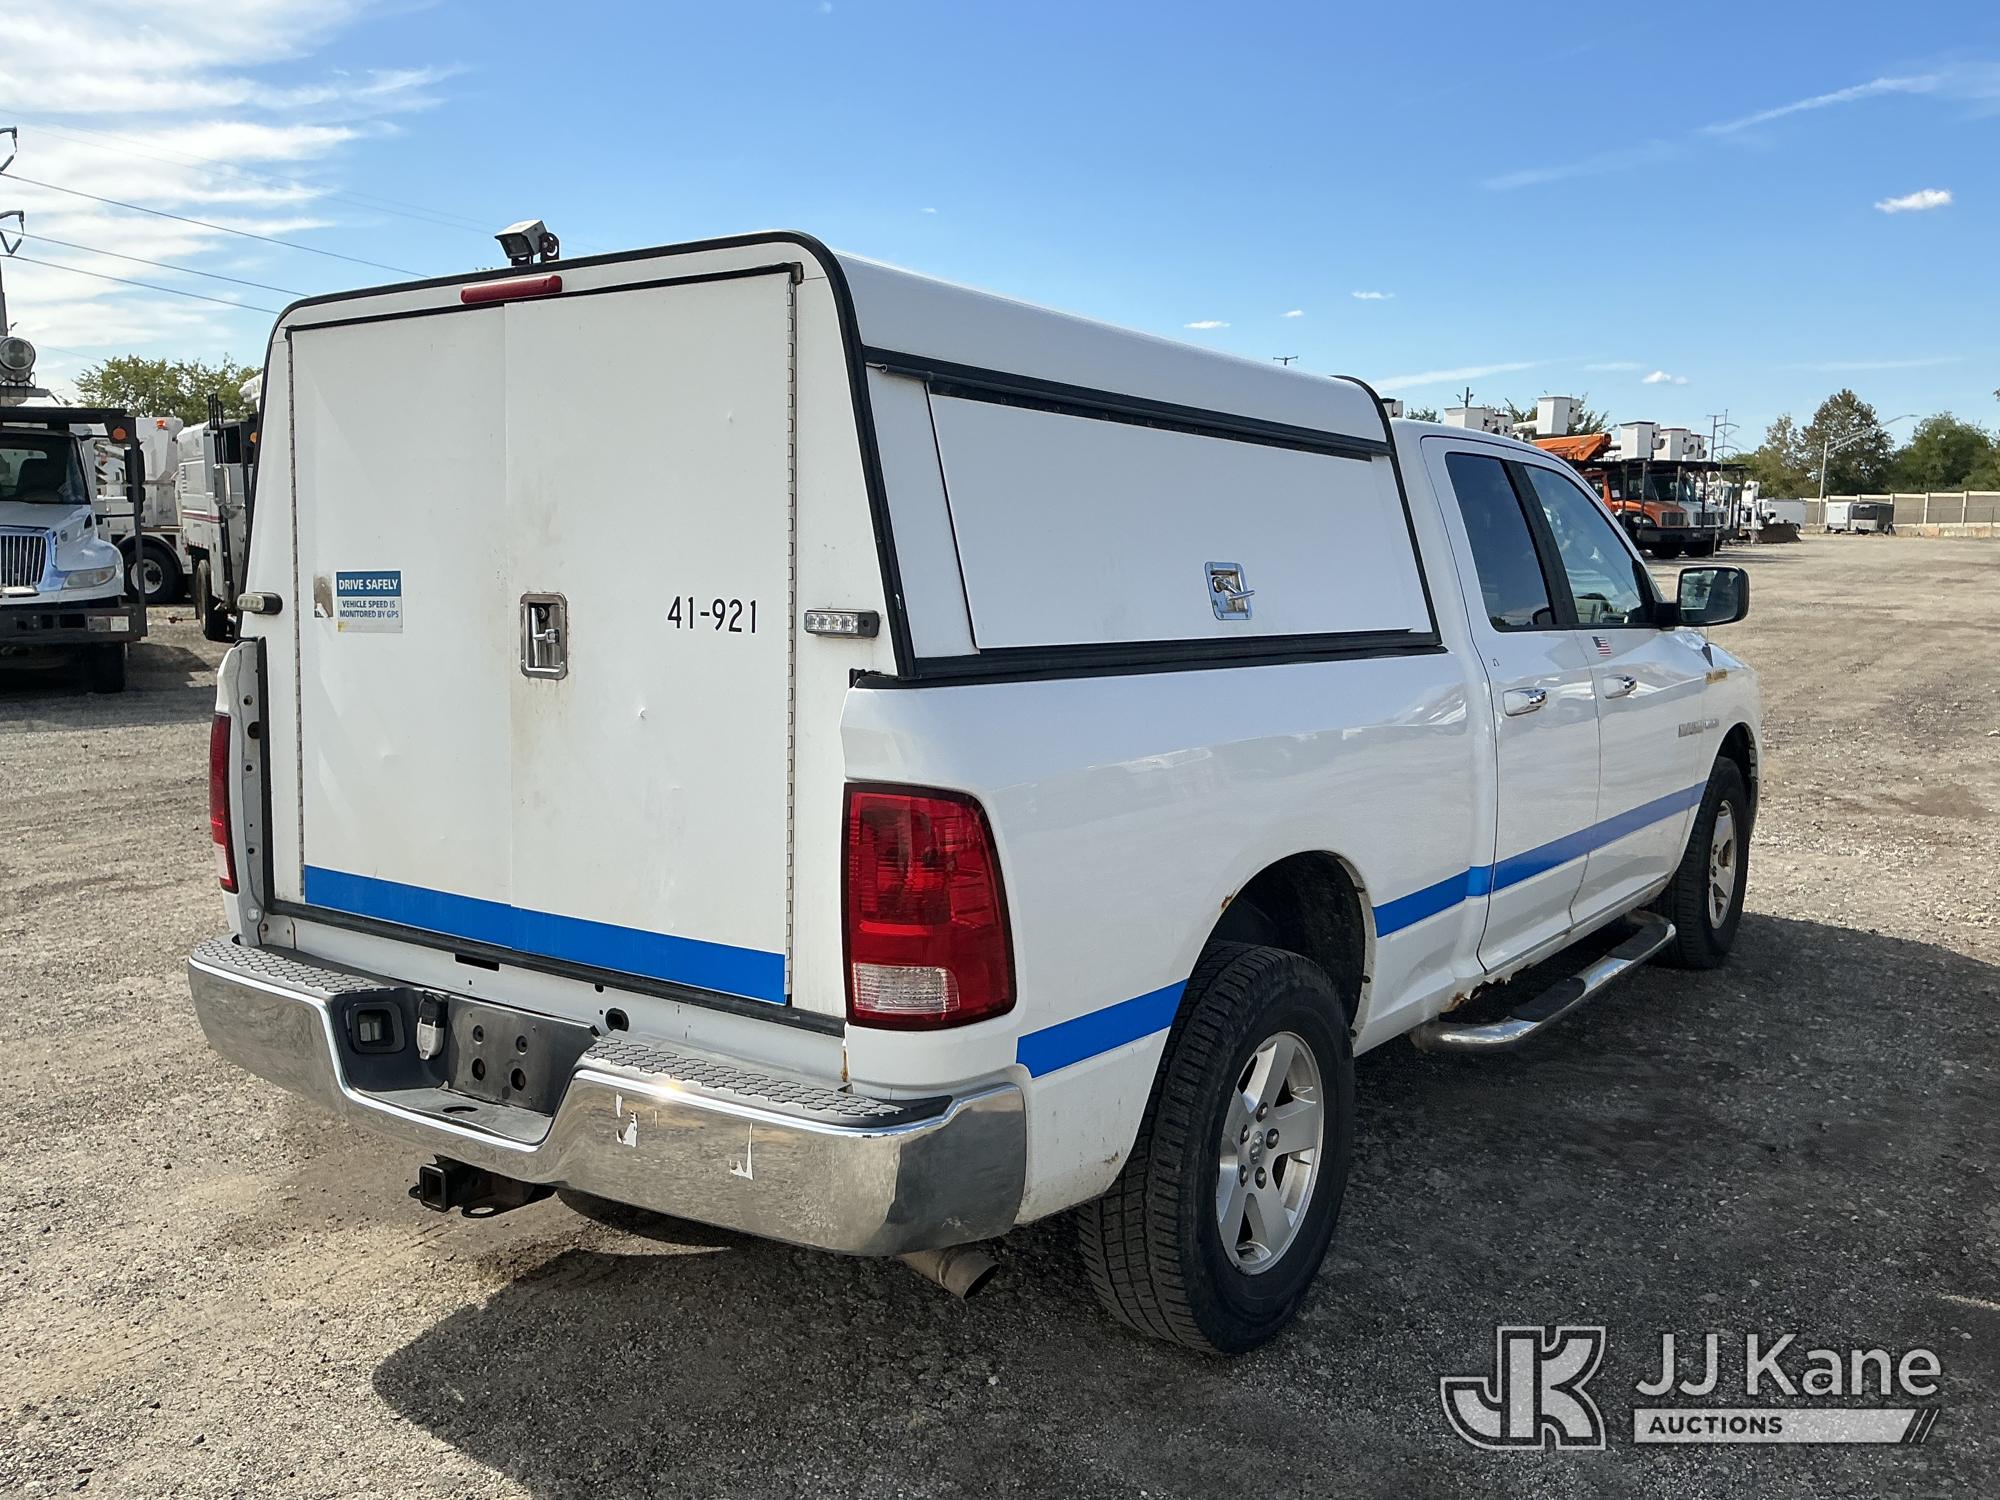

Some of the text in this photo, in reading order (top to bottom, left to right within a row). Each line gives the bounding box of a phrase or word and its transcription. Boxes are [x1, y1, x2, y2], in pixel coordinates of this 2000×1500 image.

[338, 578, 399, 591] DRIVE SAFELY
[342, 600, 396, 608] VEHICLE SPEED IS
[339, 610, 399, 618] MONITORED BY GPS
[667, 595, 757, 634] 41-921
